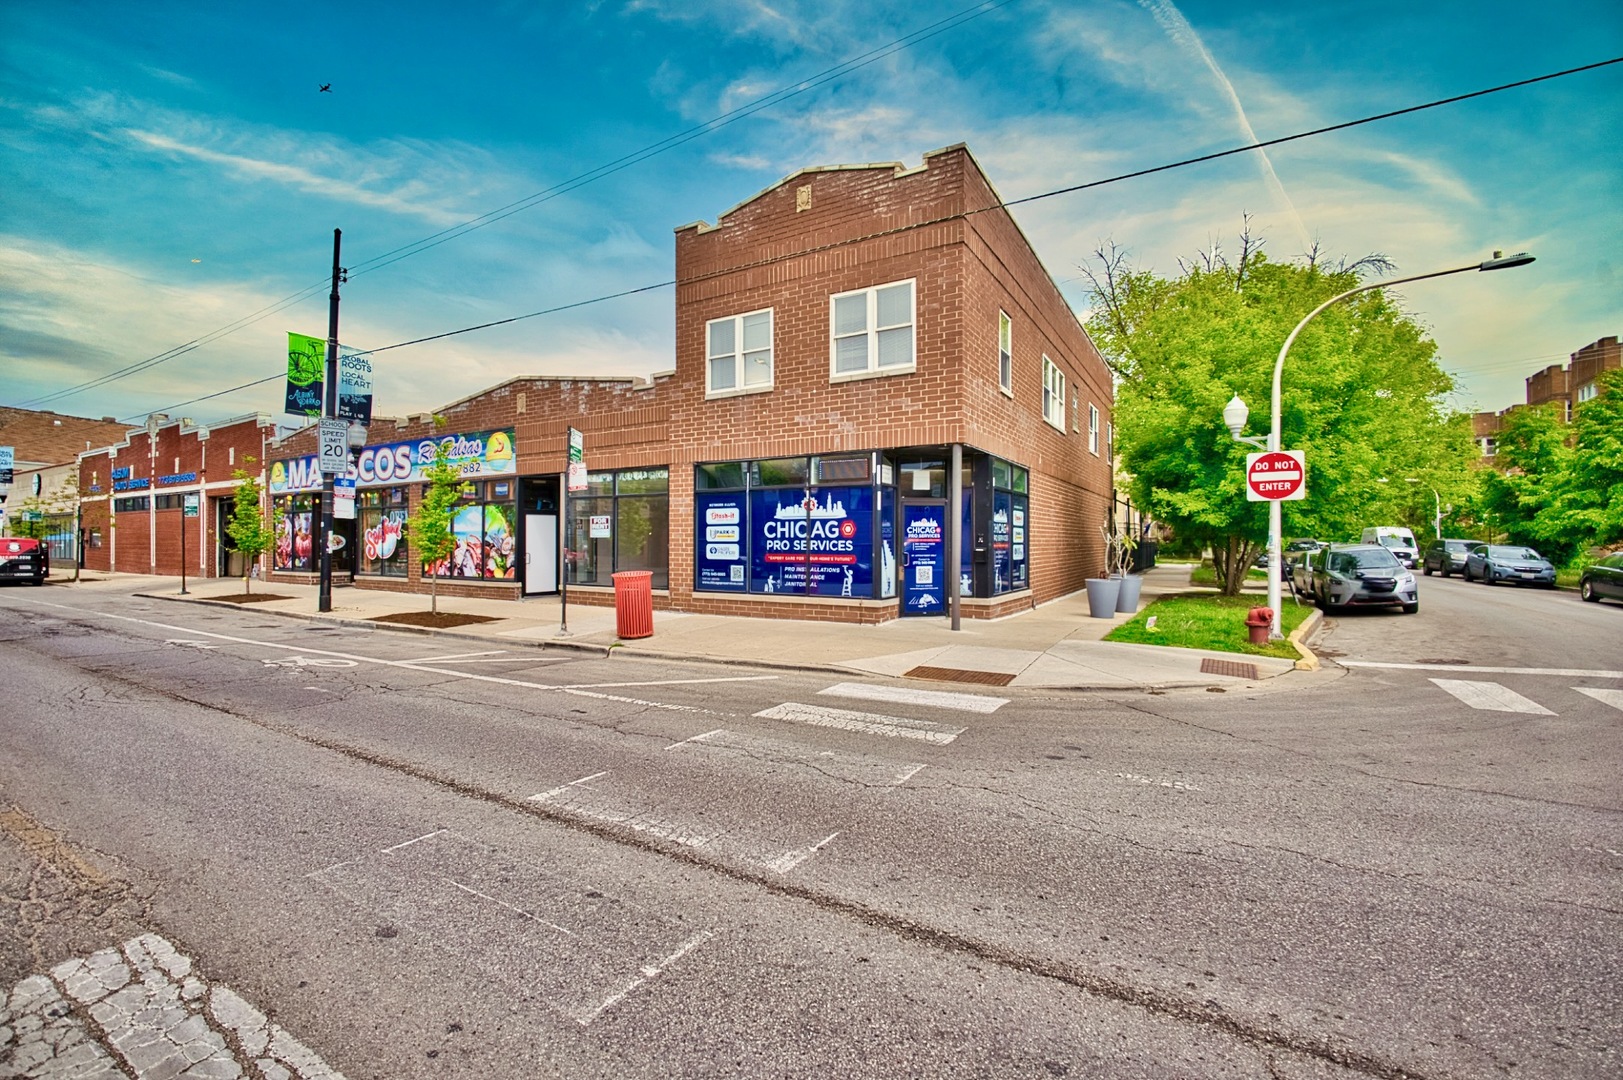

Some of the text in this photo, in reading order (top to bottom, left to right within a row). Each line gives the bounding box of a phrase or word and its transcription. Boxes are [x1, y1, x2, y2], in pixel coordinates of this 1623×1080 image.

[342, 354, 370, 365] GLOBAL
[342, 362, 372, 372] ROOTS
[342, 371, 365, 380] LOCAL
[341, 378, 371, 388] HEART
[321, 420, 346, 428] SCHOOL
[324, 444, 343, 457] 20
[1255, 461, 1294, 470] DO NOT
[128, 478, 149, 489] SERVICE
[1260, 482, 1291, 491] ENTER
[766, 540, 853, 551] PRO SERVICES
